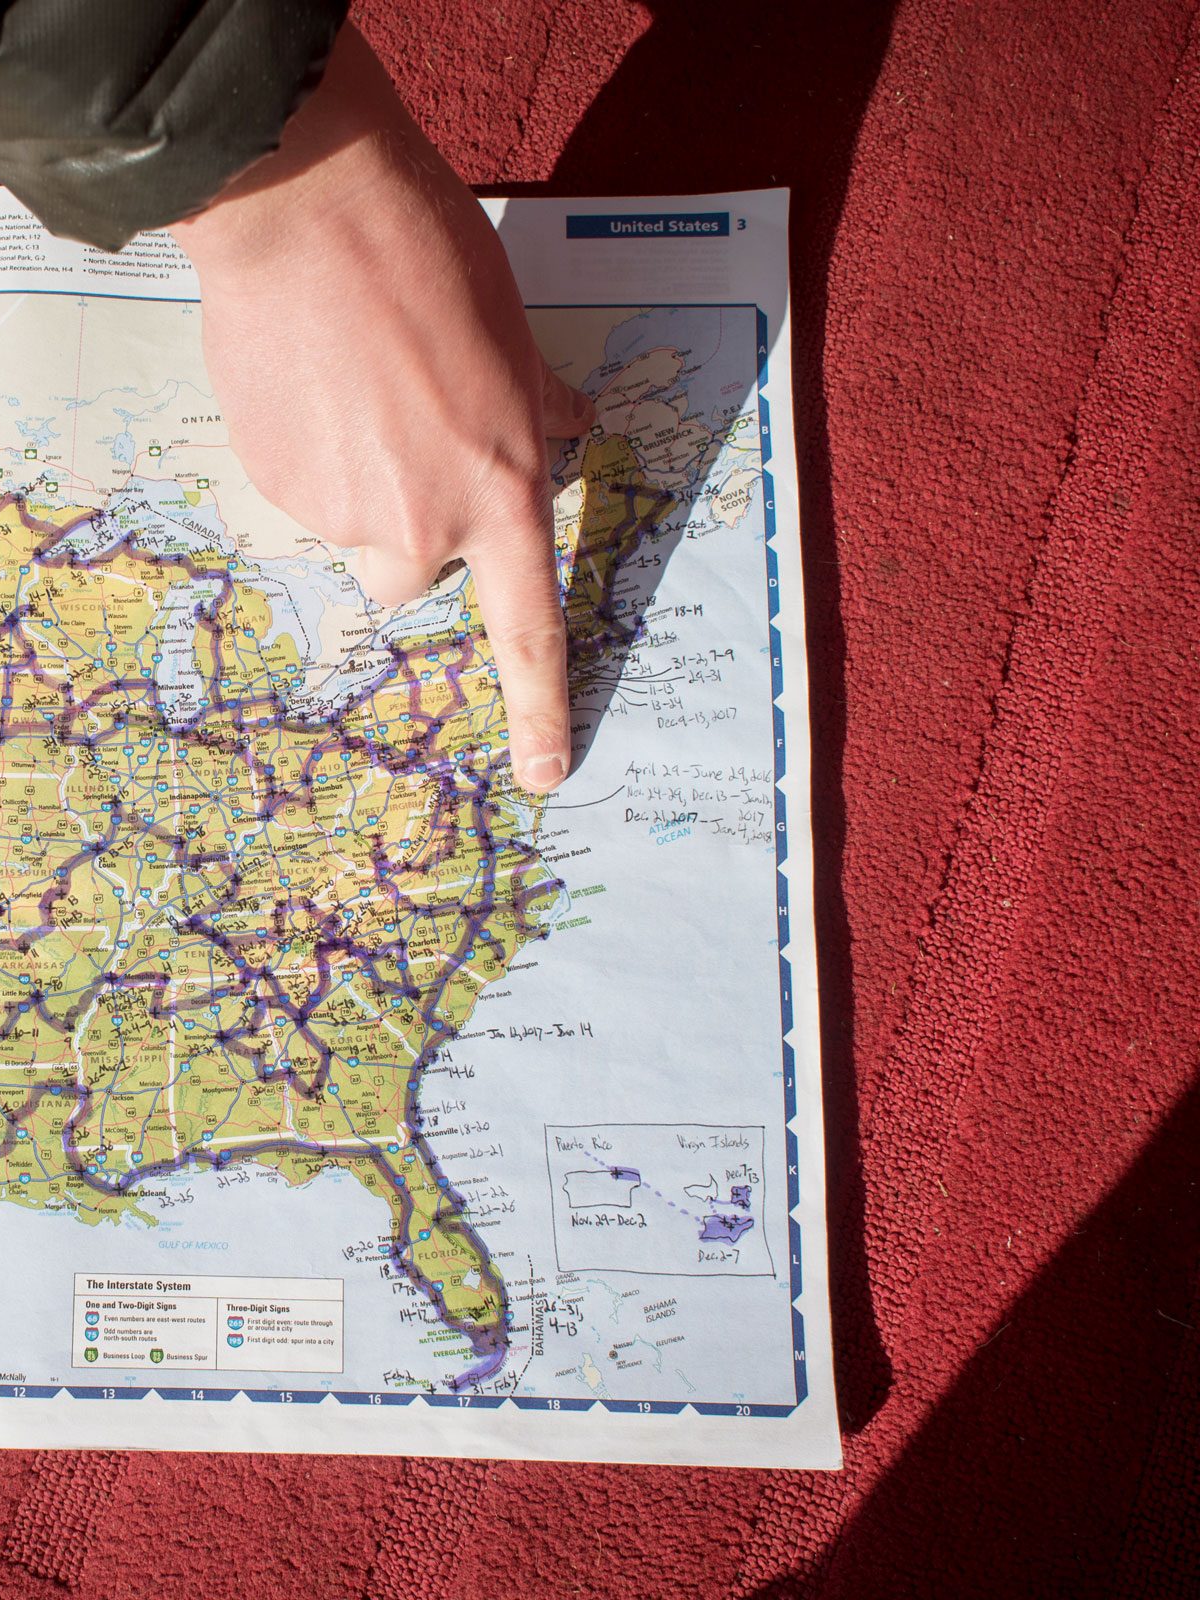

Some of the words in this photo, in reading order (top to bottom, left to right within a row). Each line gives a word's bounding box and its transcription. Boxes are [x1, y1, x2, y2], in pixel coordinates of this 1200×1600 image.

[610, 221, 664, 233] United
[669, 221, 718, 232] States
[737, 219, 746, 230] 3
[655, 427, 675, 438] NEW
[643, 428, 693, 451] BRUNSWICK
[719, 489, 745, 502] NOVA
[721, 494, 752, 511] SCOTIA
[60, 603, 124, 611] WISCONSIN
[166, 716, 197, 724] Chicago
[321, 1035, 377, 1045] GEORGIA
[158, 1241, 177, 1250] GULF
[195, 1242, 228, 1250] MEXICO
[418, 1249, 465, 1260] FLORIDA
[87, 1280, 105, 1290] The
[107, 1280, 153, 1290] Interstate
[156, 1281, 191, 1291] System
[118, 1302, 154, 1310] Two-Digit
[156, 1302, 177, 1310] Signs
[226, 1304, 268, 1312] Three-Digit
[270, 1305, 290, 1313] Signs
[644, 1298, 677, 1314] BAHAMA
[646, 1308, 676, 1322] ISLANDS
[262, 1319, 274, 1327] digit
[311, 1320, 333, 1328] through
[534, 1299, 544, 1355] BAHAMAS
[507, 1325, 528, 1333] Miami
[262, 1337, 274, 1345] digit
[323, 1338, 334, 1346] city
[131, 1353, 145, 1361] Loop
[0, 1373, 26, 1383] McNally
[13, 1388, 25, 1397] 12
[103, 1389, 115, 1399] 13
[191, 1390, 204, 1400] 14
[280, 1393, 293, 1402] 15
[369, 1395, 381, 1404] 16
[458, 1397, 470, 1406] 17
[547, 1400, 560, 1409] 18
[638, 1403, 650, 1412] 19
[736, 1406, 750, 1416] 20
